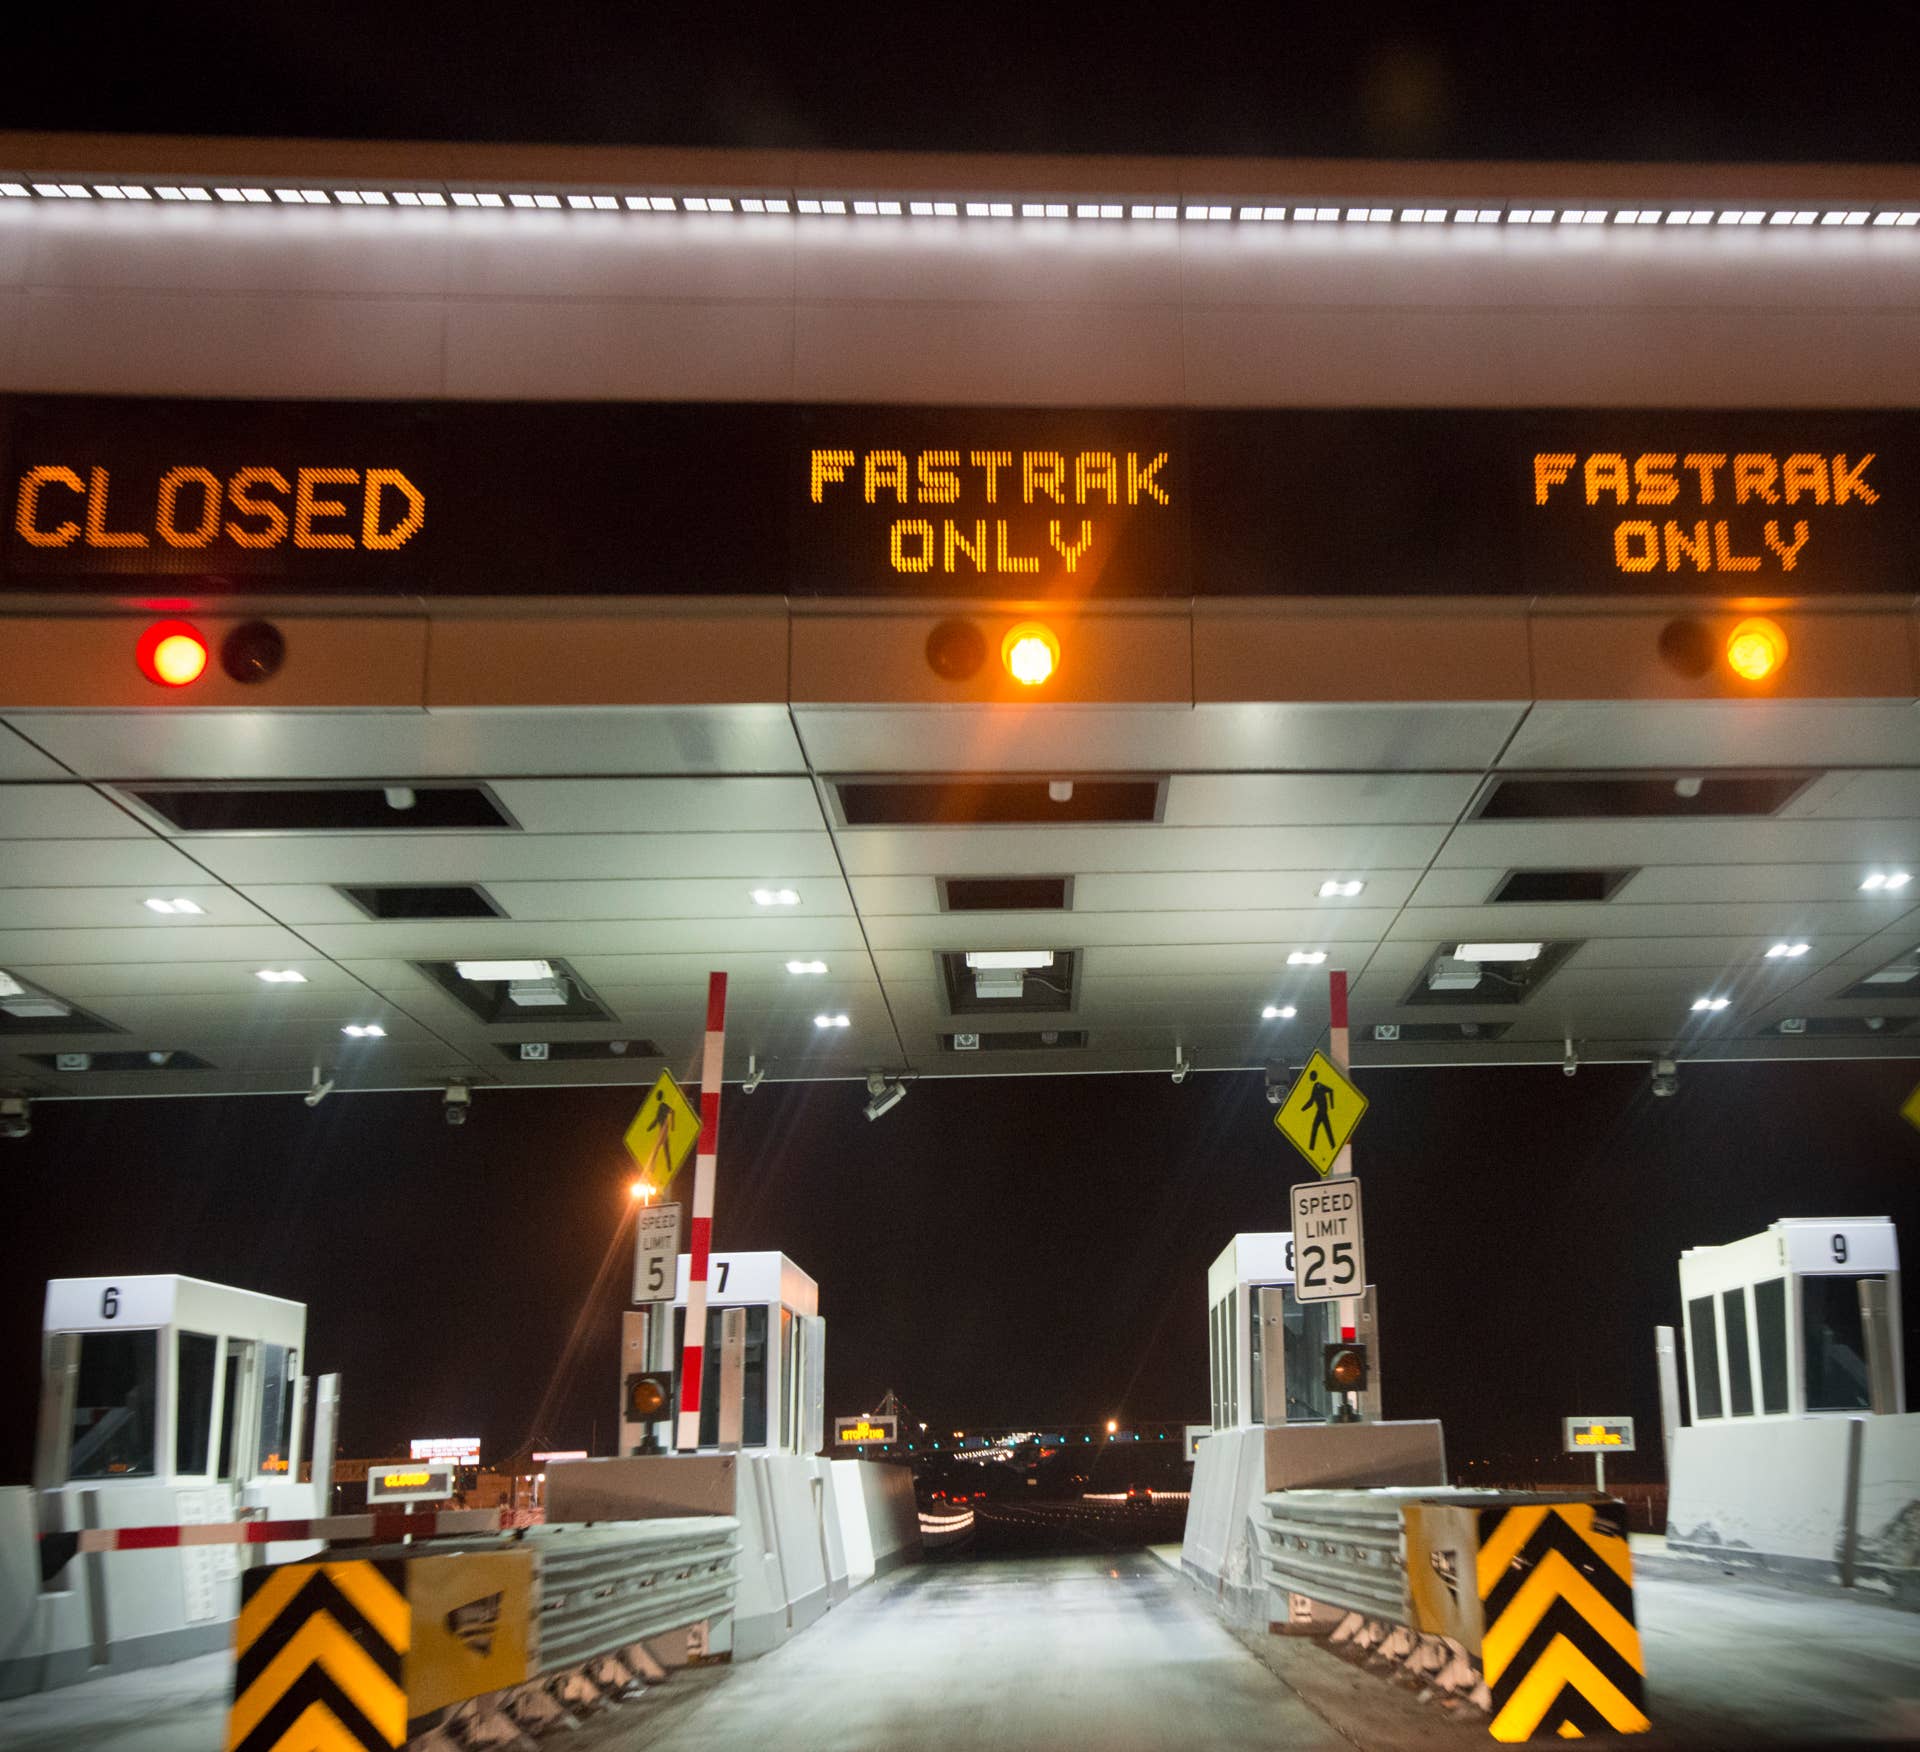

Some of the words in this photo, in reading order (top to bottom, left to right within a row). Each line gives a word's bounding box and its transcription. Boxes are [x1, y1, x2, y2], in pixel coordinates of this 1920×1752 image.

[811, 450, 1169, 505] FASTRAK
[1534, 453, 1881, 506] FASTRAK
[15, 465, 426, 551] CLOSED
[891, 520, 1092, 573] ONLY
[1614, 520, 1809, 573] ONLY
[1299, 1194, 1353, 1215] SPEED
[641, 1214, 676, 1230] SPEED
[1306, 1218, 1347, 1238] LIMIT
[643, 1235, 673, 1251] LIMIT
[1831, 1233, 1847, 1264] 9
[648, 1257, 664, 1292] 5
[716, 1262, 730, 1293] 7
[1302, 1242, 1355, 1287] 25
[102, 1287, 120, 1320] 6
